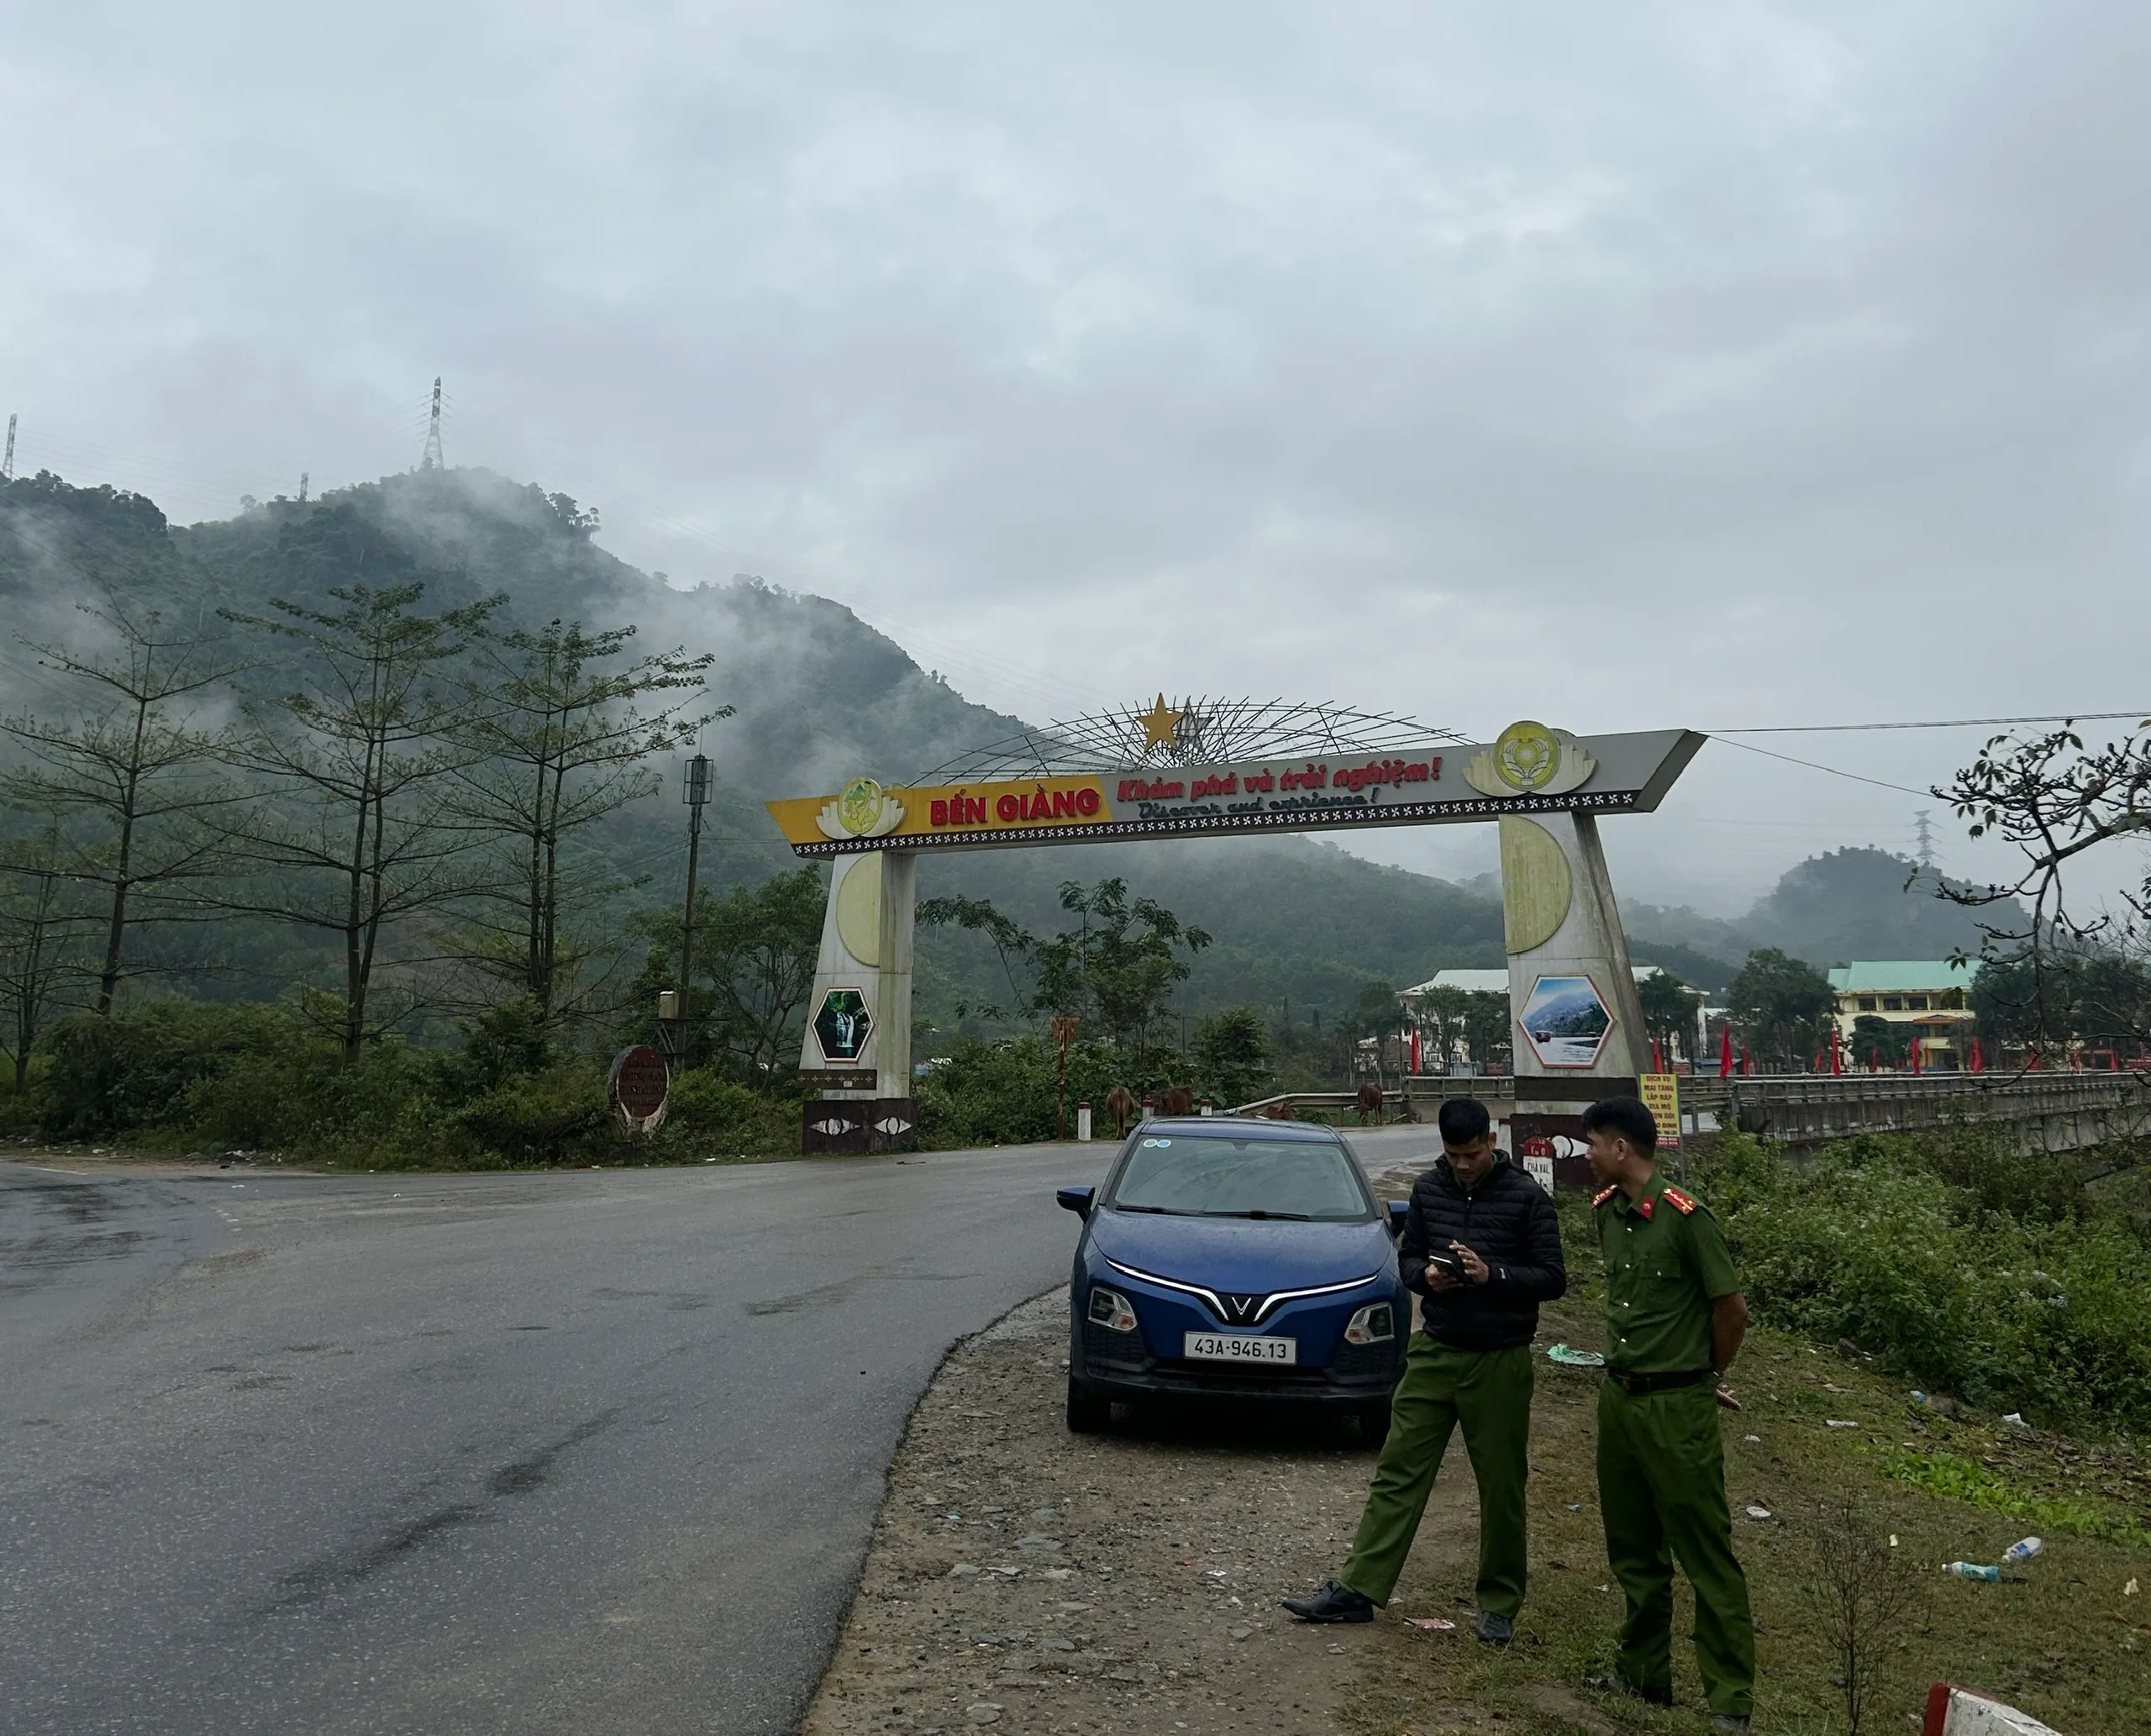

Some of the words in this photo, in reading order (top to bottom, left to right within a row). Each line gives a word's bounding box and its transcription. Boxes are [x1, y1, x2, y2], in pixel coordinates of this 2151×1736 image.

[1117, 776, 1184, 802] Khám
[1190, 771, 1238, 802] phá
[1244, 767, 1275, 793] và
[1280, 763, 1328, 791] trải
[930, 788, 987, 825] BẾN
[1228, 797, 1264, 813] and
[1195, 1339, 1286, 1359] 43A-946.13
